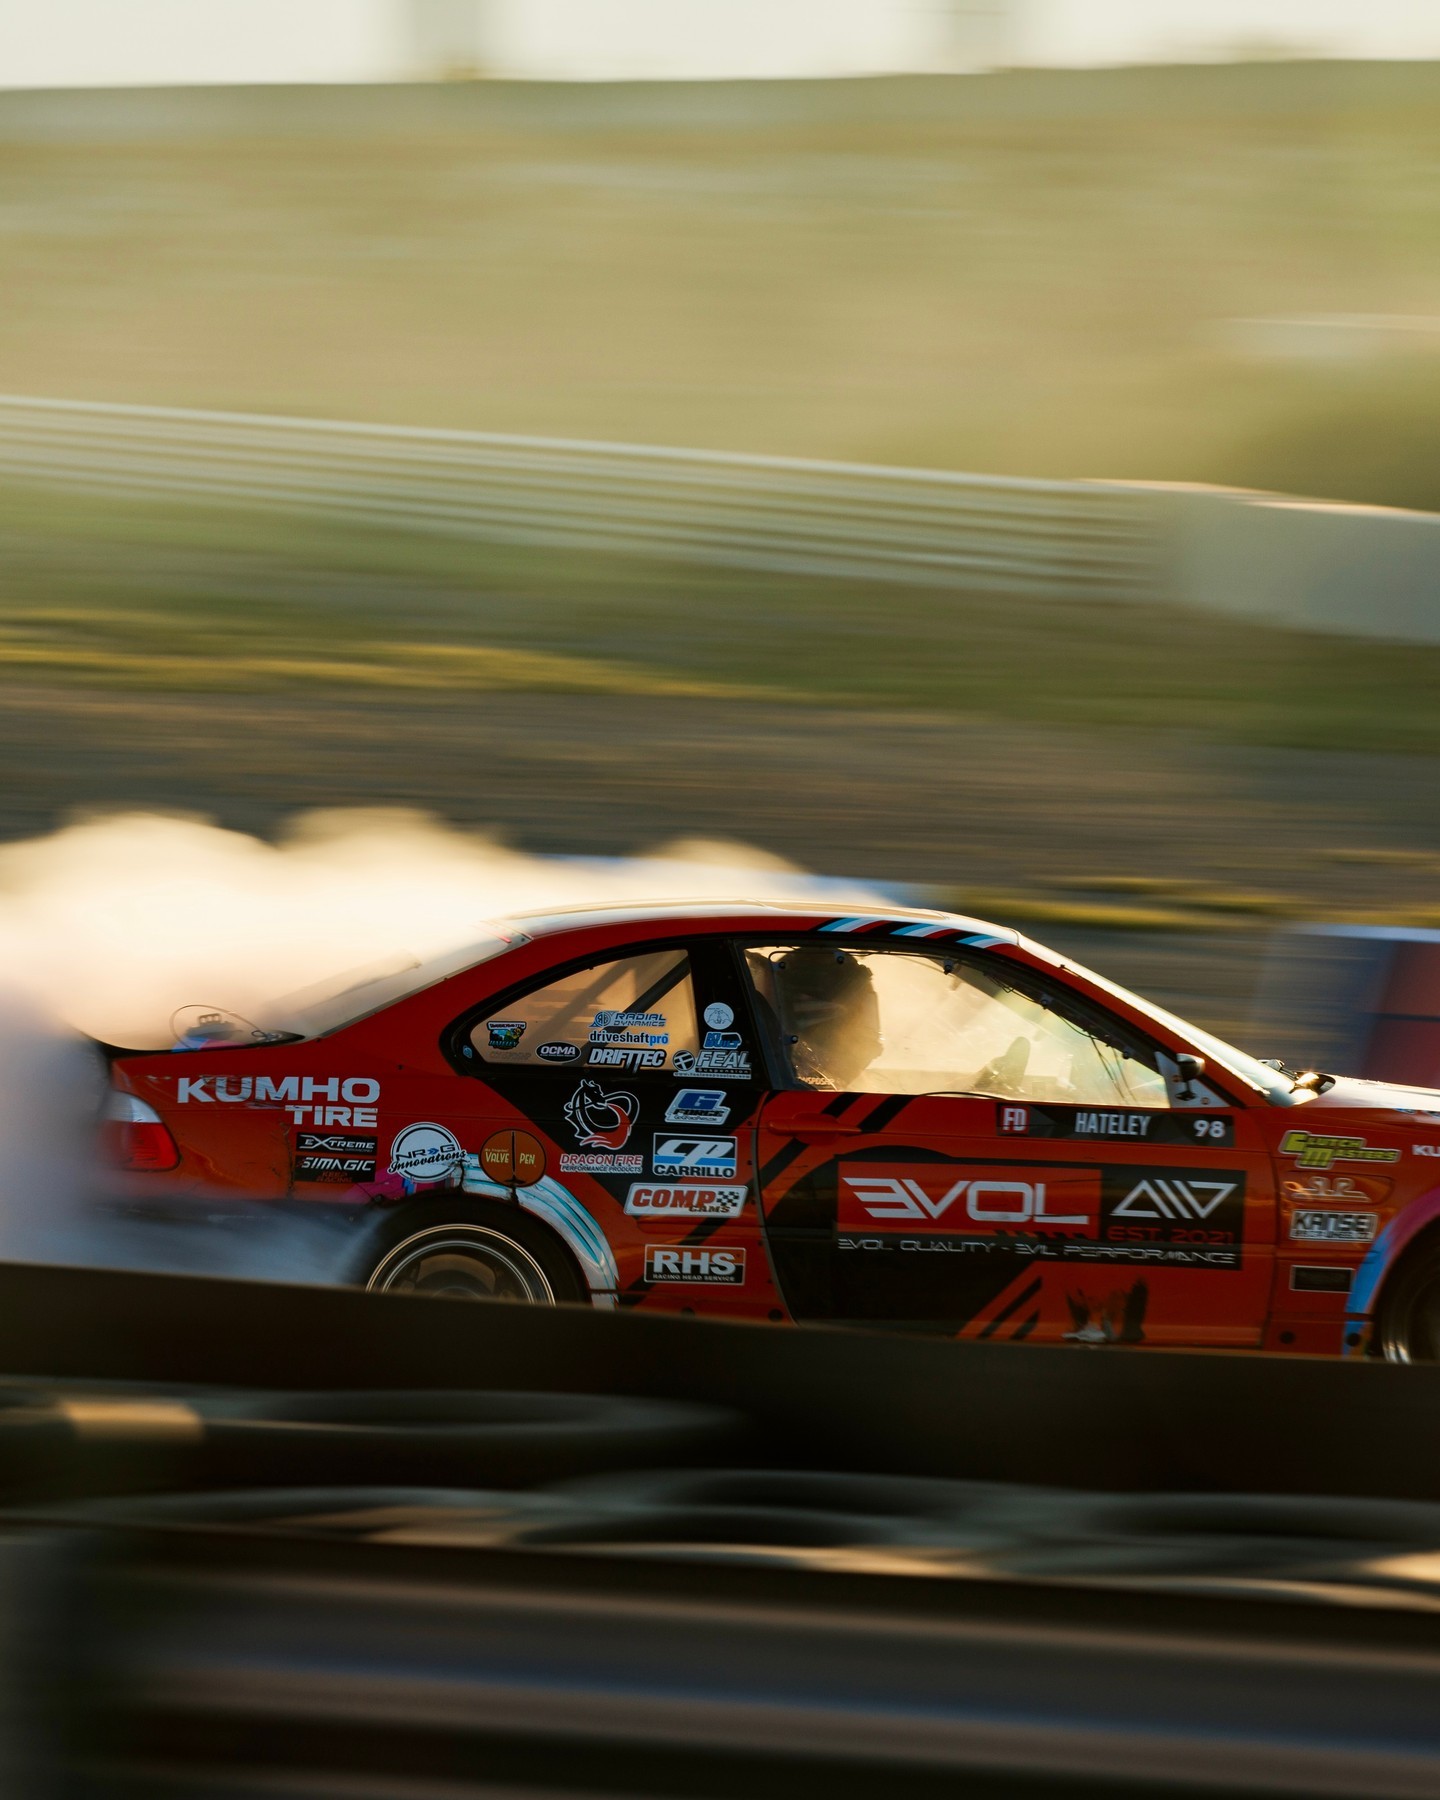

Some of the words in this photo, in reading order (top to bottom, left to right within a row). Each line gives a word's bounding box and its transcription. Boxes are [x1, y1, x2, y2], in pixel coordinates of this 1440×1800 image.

[590, 1030, 669, 1046] driveshaftpro
[540, 1046, 576, 1055] OCMA
[696, 1051, 751, 1068] FEAL
[177, 1076, 381, 1103] KUMHO
[285, 1104, 378, 1128] TIRE
[1002, 1107, 1027, 1131] FD
[1075, 1112, 1151, 1136] HATELEY
[1193, 1120, 1226, 1138] 98
[301, 1157, 376, 1171] SIMAGIC
[388, 1149, 466, 1173] Innovations
[485, 1152, 510, 1164] VALVE
[519, 1153, 535, 1165] PEN
[560, 1154, 615, 1166] DRAGON
[616, 1155, 643, 1166] FIRE
[562, 1164, 607, 1172] PERFORMANCE
[654, 1165, 735, 1178] CARRILLO
[632, 1188, 716, 1208] COMP
[842, 1177, 1089, 1225] EVOL
[689, 1205, 731, 1213] CAMS
[1106, 1226, 1165, 1243] EST.
[1169, 1228, 1234, 1246] 2021
[837, 1238, 893, 1251] EVOL
[900, 1239, 996, 1254] QUALITY
[1013, 1242, 1058, 1256] EVIL
[1063, 1245, 1236, 1264] PERFORMANCE
[653, 1250, 736, 1276] RHS
